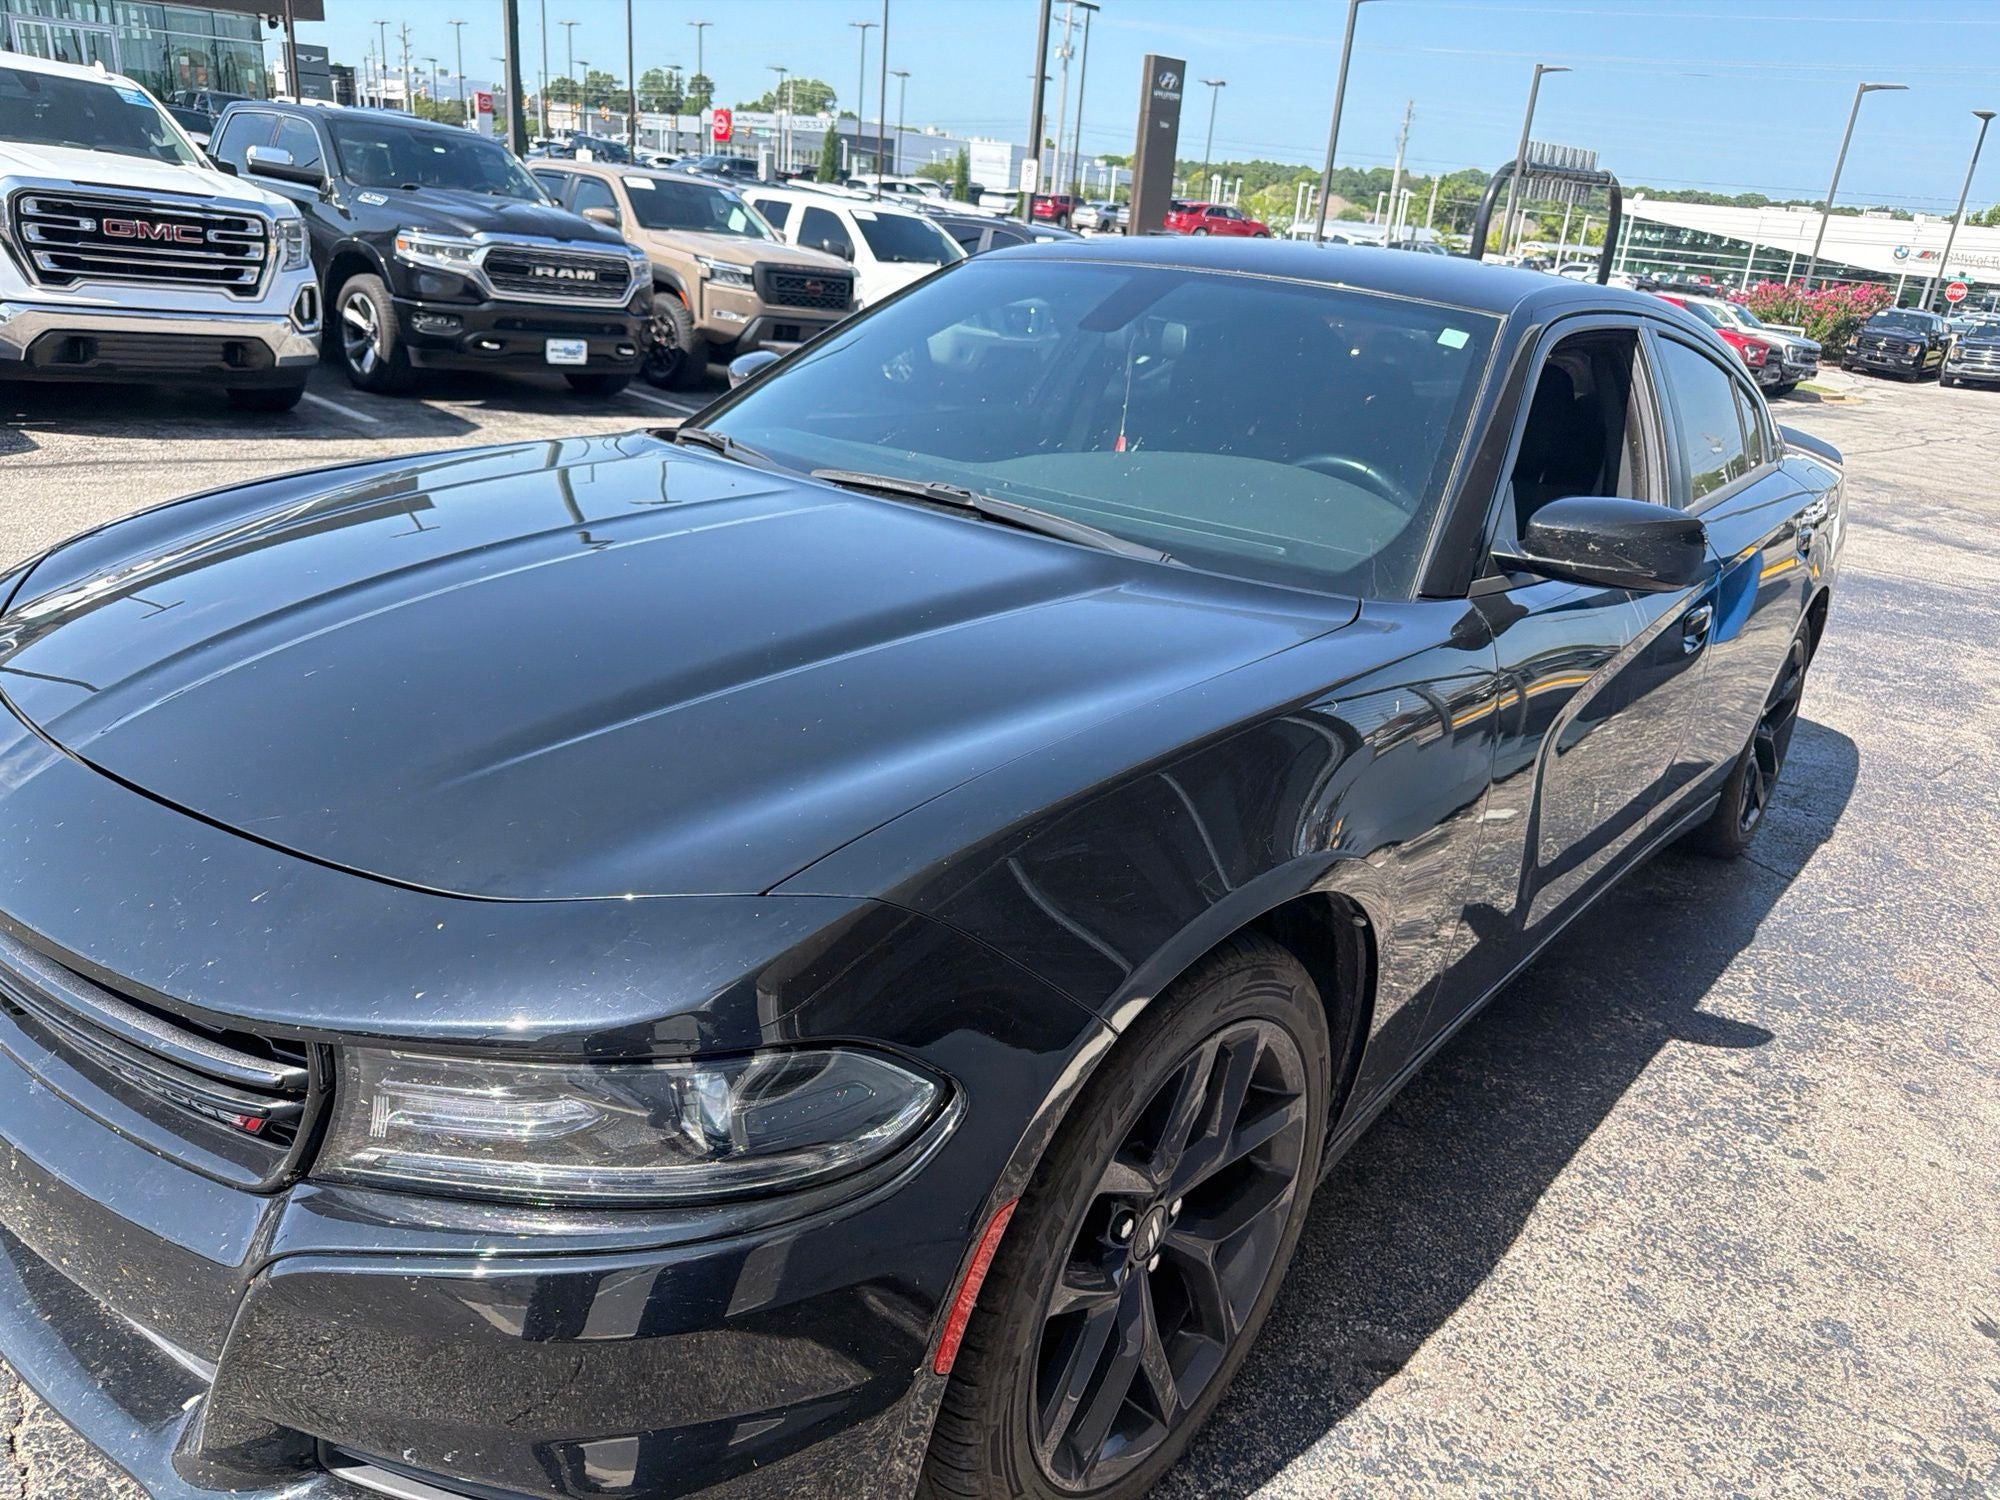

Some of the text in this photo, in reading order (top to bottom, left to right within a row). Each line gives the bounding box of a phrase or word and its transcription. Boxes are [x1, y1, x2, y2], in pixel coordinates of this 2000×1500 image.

[103, 218, 204, 244] GMC
[534, 266, 596, 281] RAM
[1947, 288, 1966, 297] STOP
